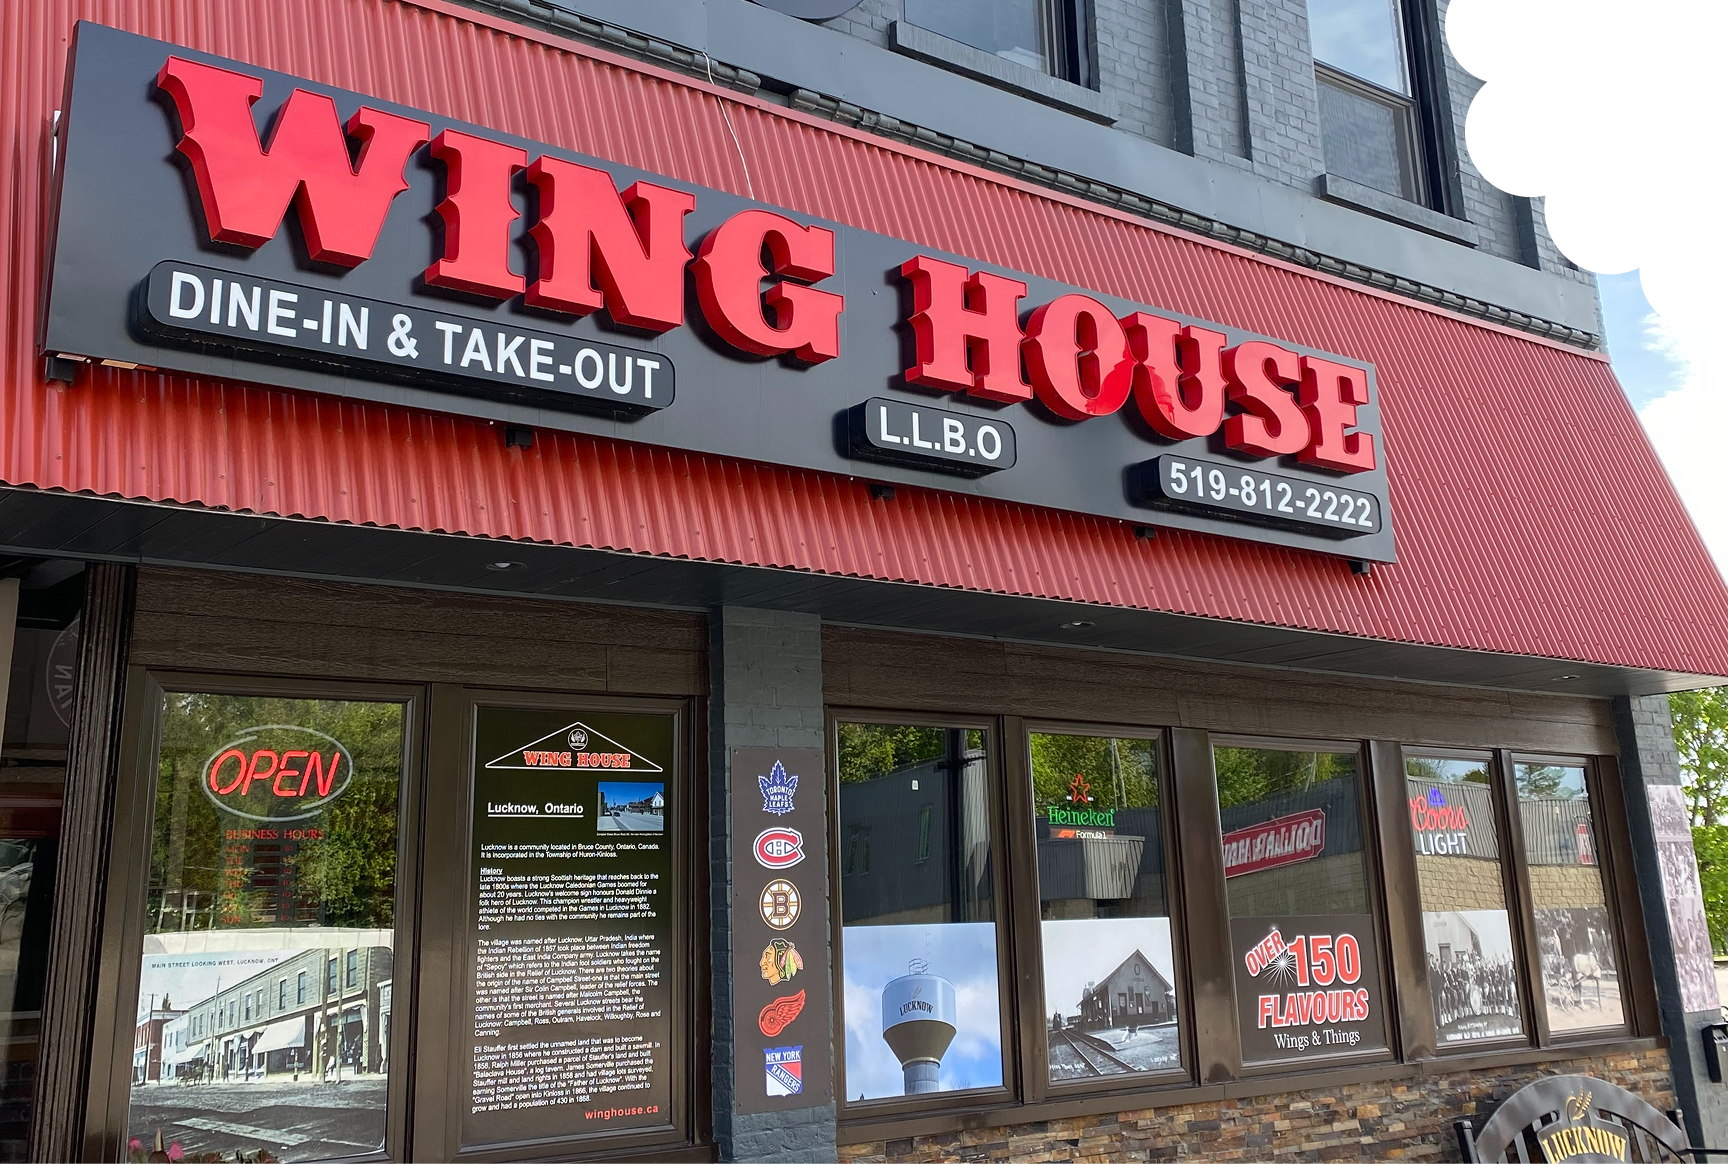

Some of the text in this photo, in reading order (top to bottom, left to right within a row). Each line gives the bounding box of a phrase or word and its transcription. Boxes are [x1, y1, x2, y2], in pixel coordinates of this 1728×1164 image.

[157, 54, 1376, 474] WING HOUSE
[169, 270, 661, 400] DINE-IN & TAKE-OUT
[878, 403, 1003, 463] L.L.B.O
[1169, 460, 1374, 528] 519-812-2222
[523, 751, 630, 768] WING HOUSE
[210, 750, 340, 796] OPEN
[766, 786, 792, 796] TORONTO
[488, 802, 584, 815] Lucknow, Ontario
[1047, 806, 1115, 826] Heineken
[1409, 795, 1469, 832] Coors
[226, 830, 324, 840] BUSINESS HOURS
[519, 844, 550, 852] community
[1420, 833, 1467, 855] LIGHT
[493, 852, 528, 860] incorporated
[546, 851, 572, 860] Township
[480, 867, 503, 875] History
[532, 874, 550, 883] strong
[574, 874, 596, 883] heritage
[553, 897, 580, 906] champion
[614, 896, 648, 905] heavyweight
[580, 889, 592, 898] sign
[478, 915, 505, 924] Although
[569, 912, 598, 922] community
[630, 911, 641, 920] part
[534, 906, 562, 915] competed
[1245, 930, 1361, 986] OVER 150
[900, 1000, 934, 1016] LUCKNOW
[1258, 988, 1369, 1028] FLAVOURS
[1274, 1029, 1360, 1051] Wings & Things
[766, 1050, 800, 1062] NEW YORK
[771, 1064, 800, 1092] RANGERS
[585, 1105, 659, 1120] winghouse.ca
[1542, 1126, 1627, 1164] LUCKNOW
